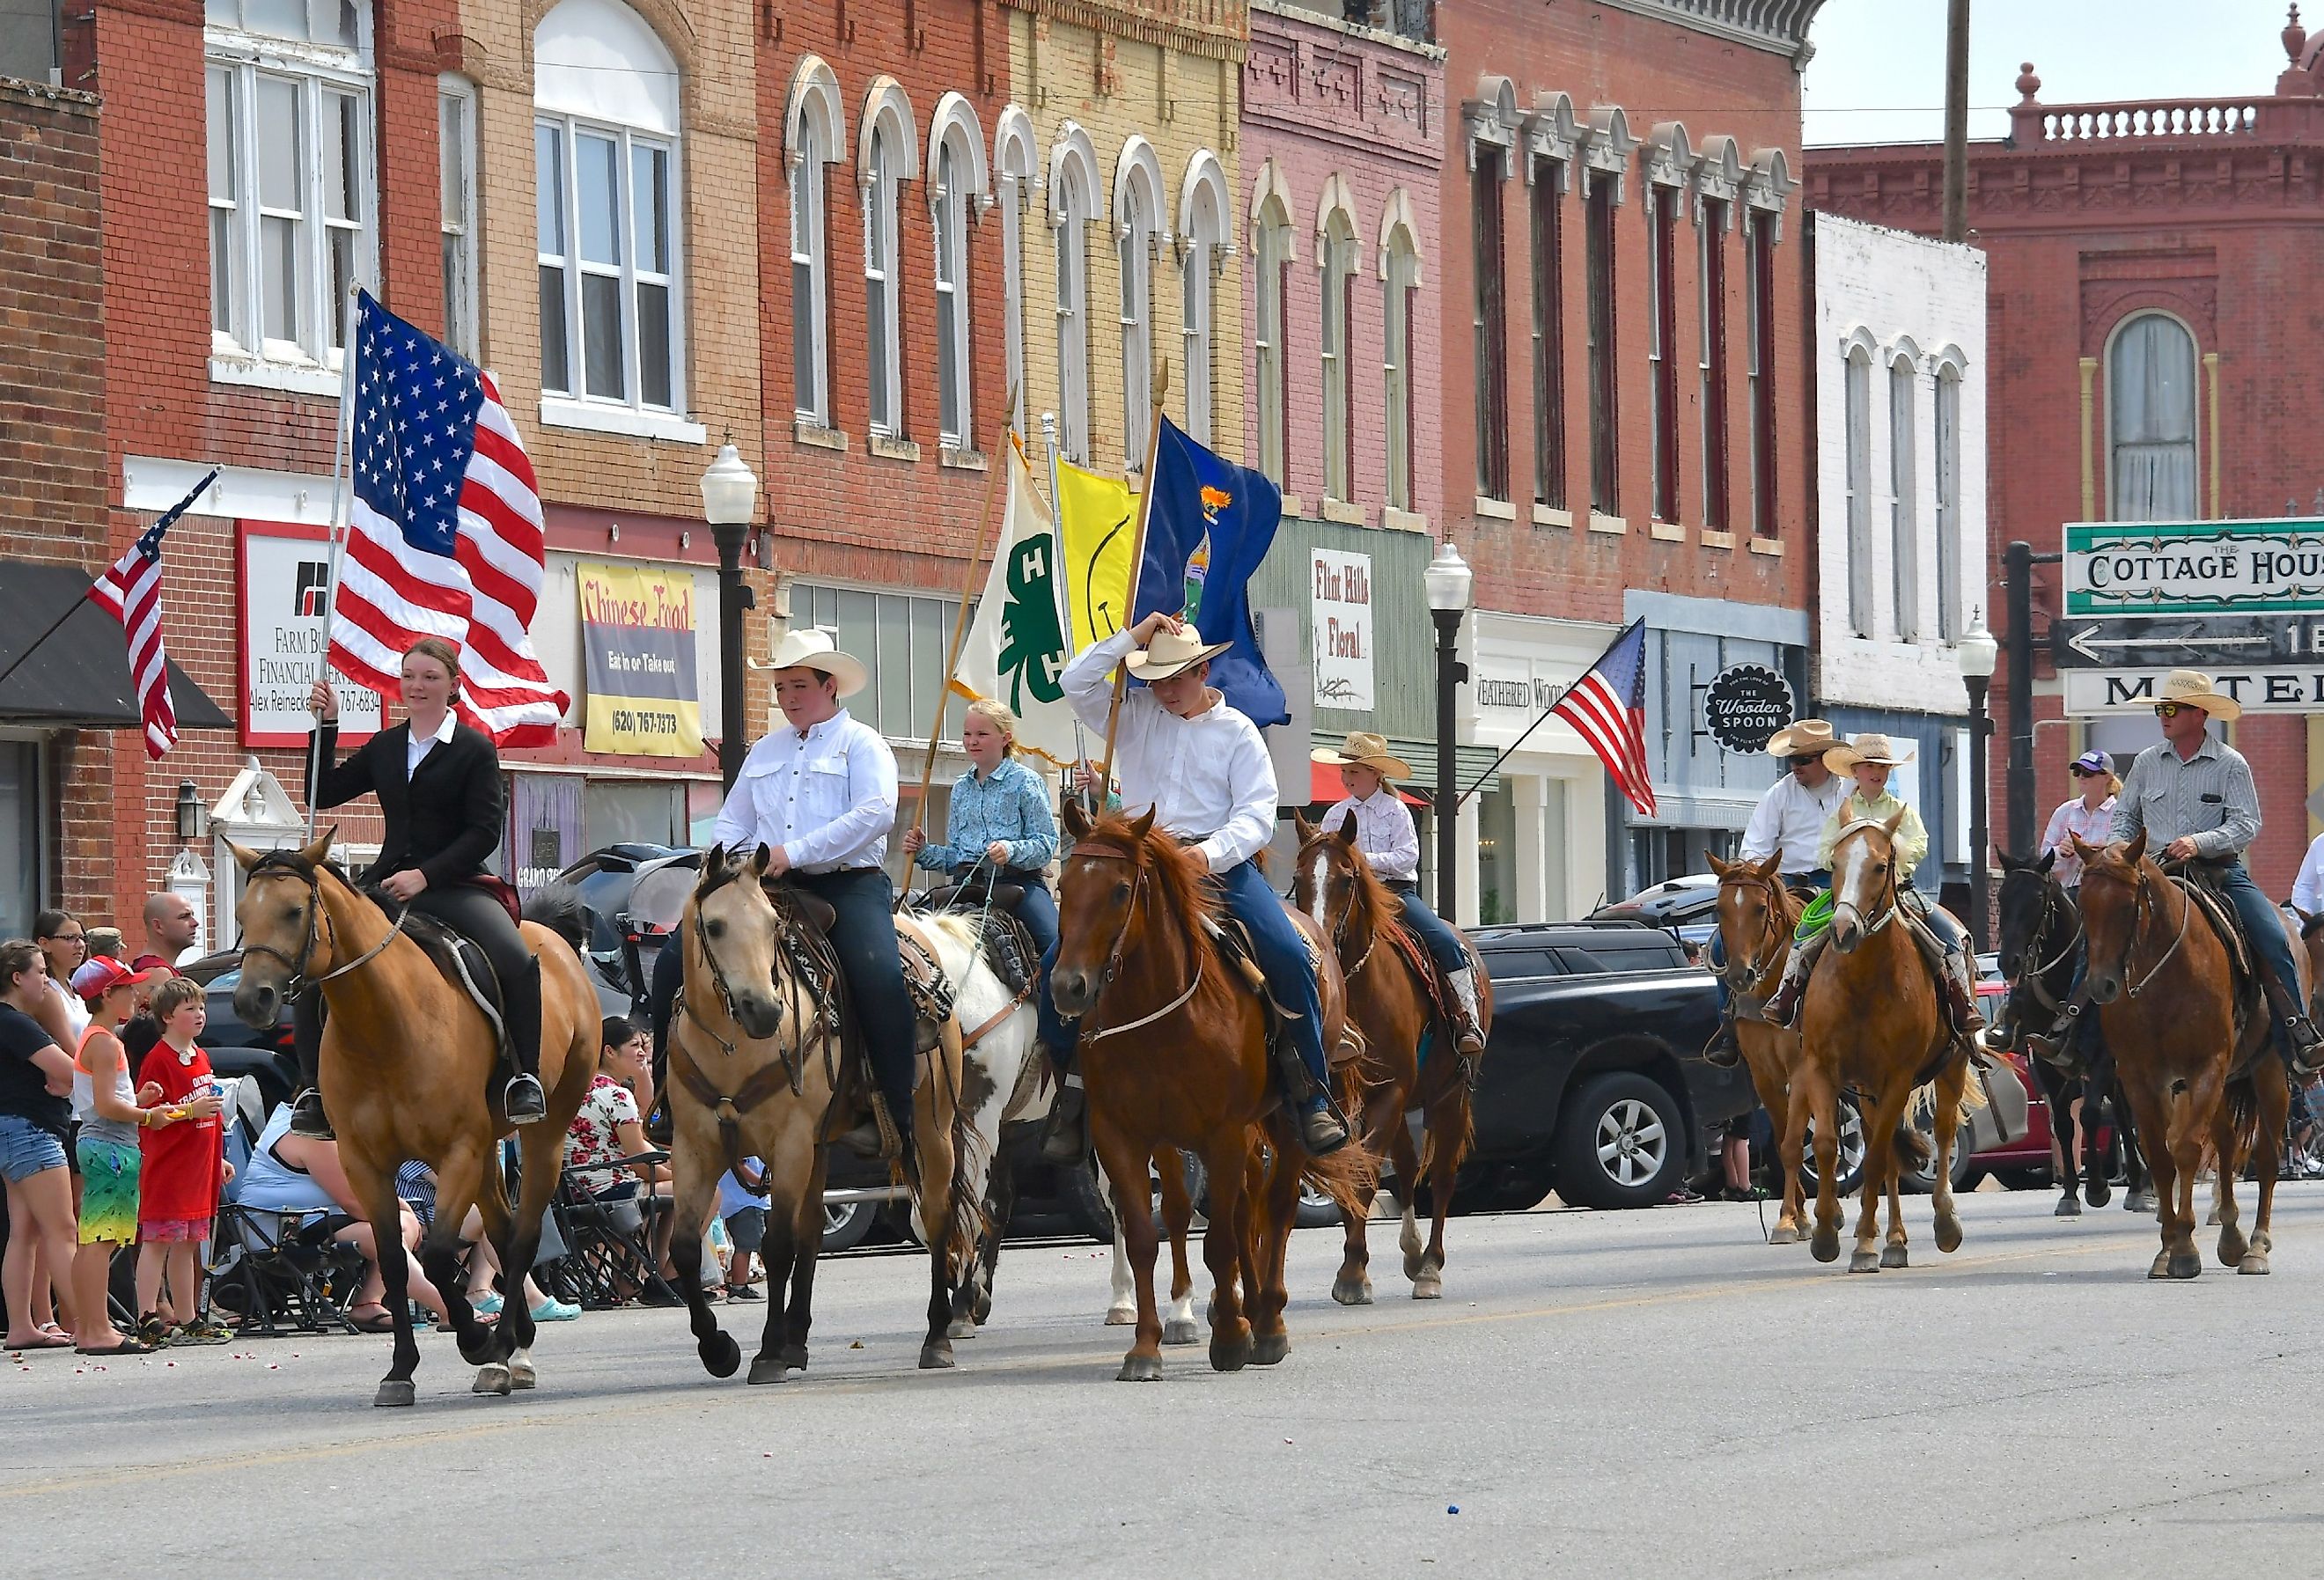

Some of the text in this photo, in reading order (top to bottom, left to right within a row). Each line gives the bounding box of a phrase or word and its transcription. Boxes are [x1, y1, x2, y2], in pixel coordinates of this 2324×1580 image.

[2211, 545, 2239, 555] THE
[1021, 547, 1046, 584] H
[2087, 551, 2324, 588] COTTAGE HOU
[1314, 559, 1369, 605] Flint Hills
[585, 579, 688, 635] Chinese Food
[275, 627, 307, 653] FARM
[1327, 616, 1361, 659] Floral
[259, 658, 315, 684] FINANCIAL
[607, 650, 621, 670] Eat
[631, 657, 641, 672] or
[642, 653, 662, 672] Take
[662, 657, 676, 673] out
[250, 688, 268, 711] Alex
[340, 690, 380, 712] 767-6834
[1475, 673, 1530, 708] EATHERED
[1715, 698, 1783, 715] Wooden
[612, 709, 677, 736] (620) 767-7373
[1722, 717, 1776, 728] SPOON
[516, 866, 546, 887] GRAND
